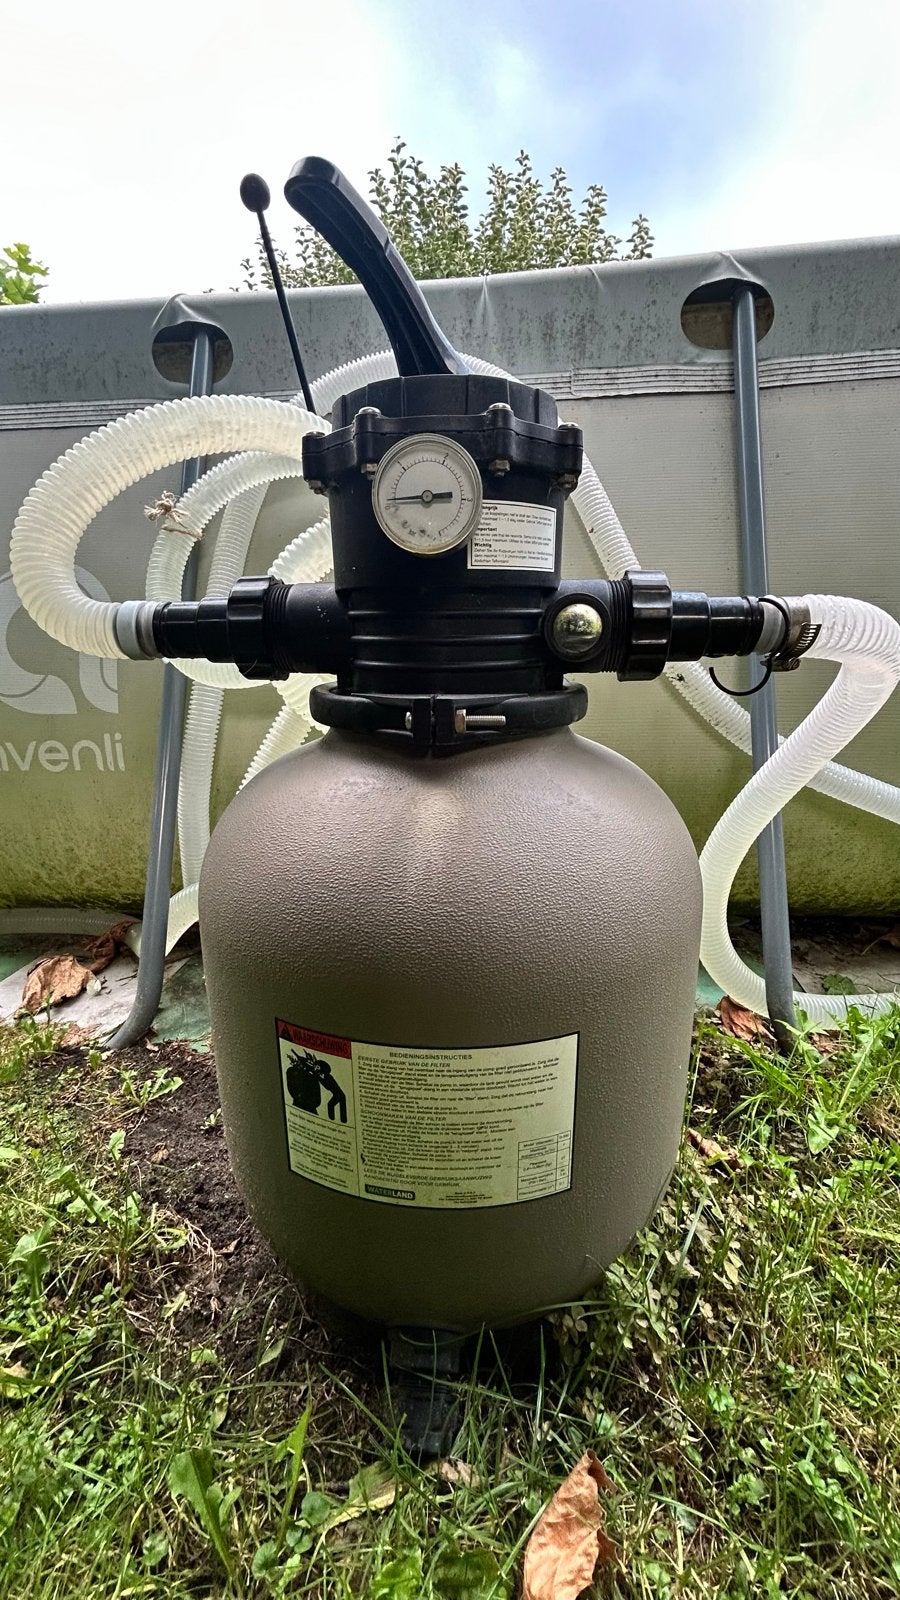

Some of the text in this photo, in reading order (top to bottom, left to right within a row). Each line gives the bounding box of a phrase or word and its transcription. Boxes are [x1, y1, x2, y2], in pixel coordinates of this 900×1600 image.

[358, 1055, 380, 1063] EERSTE
[380, 1058, 407, 1066] GEBRUIK
[389, 1051, 473, 1060] BEDIENINGSINSTRUCTIES
[360, 1108, 404, 1119] SCHOONMAKEN
[367, 1185, 413, 1200] WATERLAND
